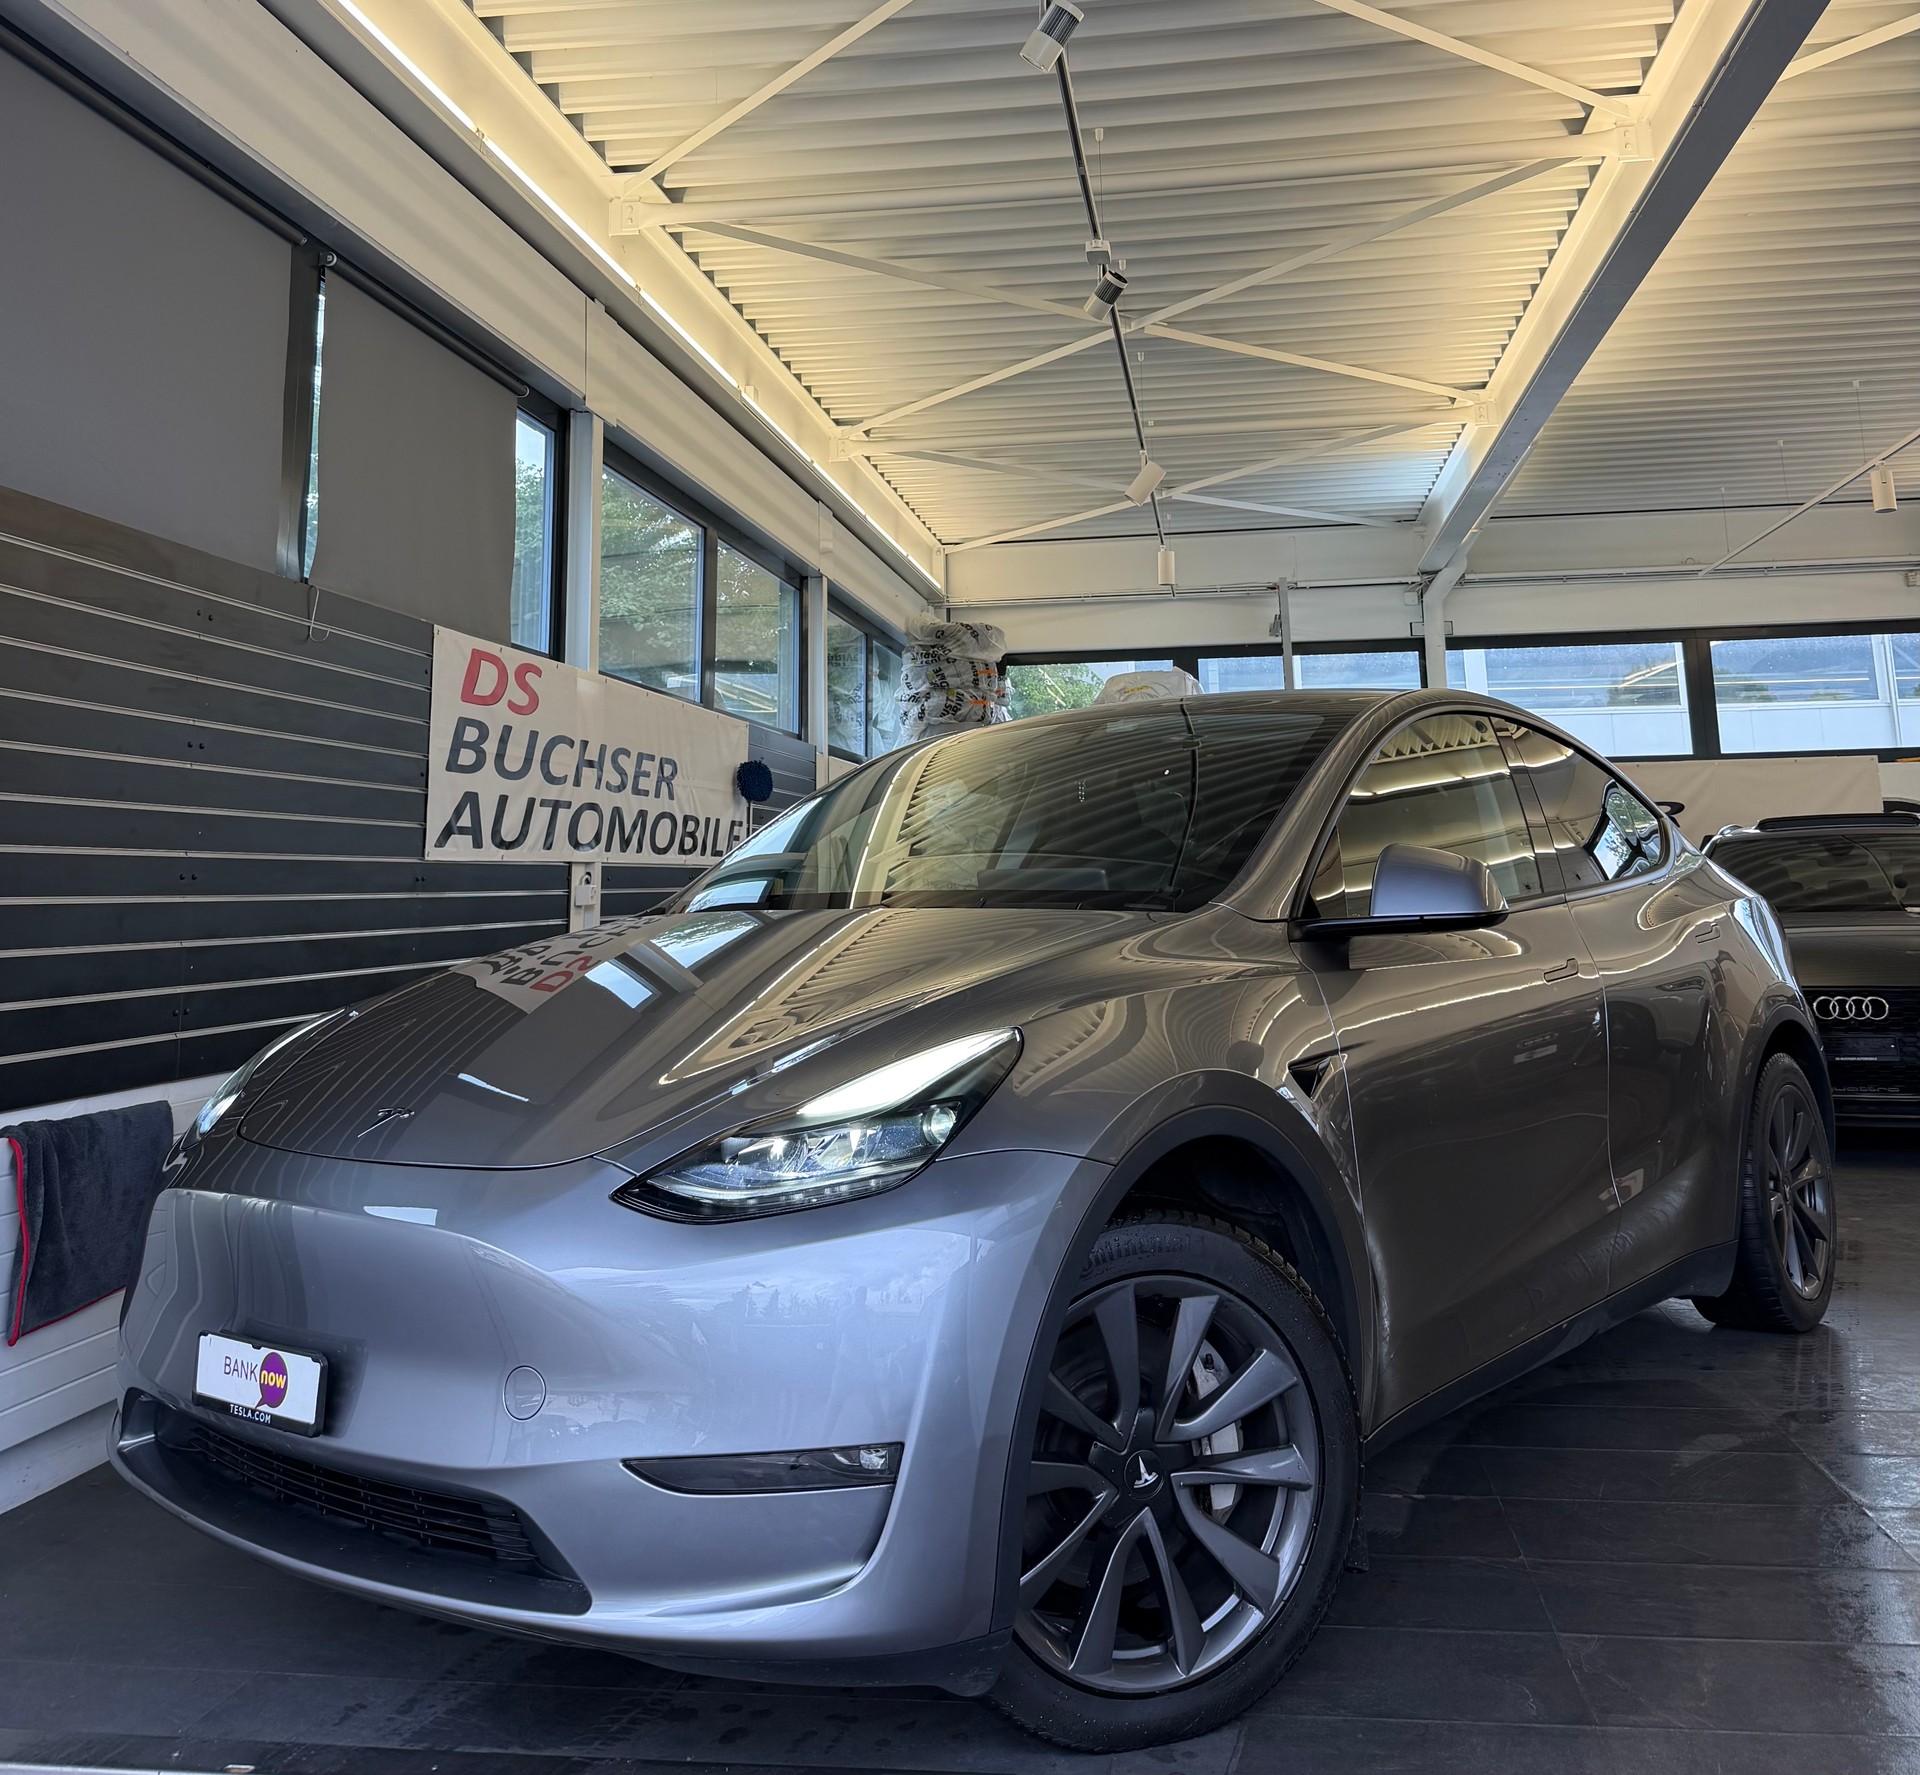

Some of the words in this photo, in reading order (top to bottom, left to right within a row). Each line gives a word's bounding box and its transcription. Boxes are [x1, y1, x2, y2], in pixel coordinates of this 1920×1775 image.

[460, 648, 542, 716] DS
[445, 717, 678, 801] BUCHSER
[434, 791, 744, 857] AUTOMOBILE
[224, 1356, 258, 1382] BANK
[261, 1370, 286, 1389] now
[230, 1404, 272, 1424] TESLA.COM
